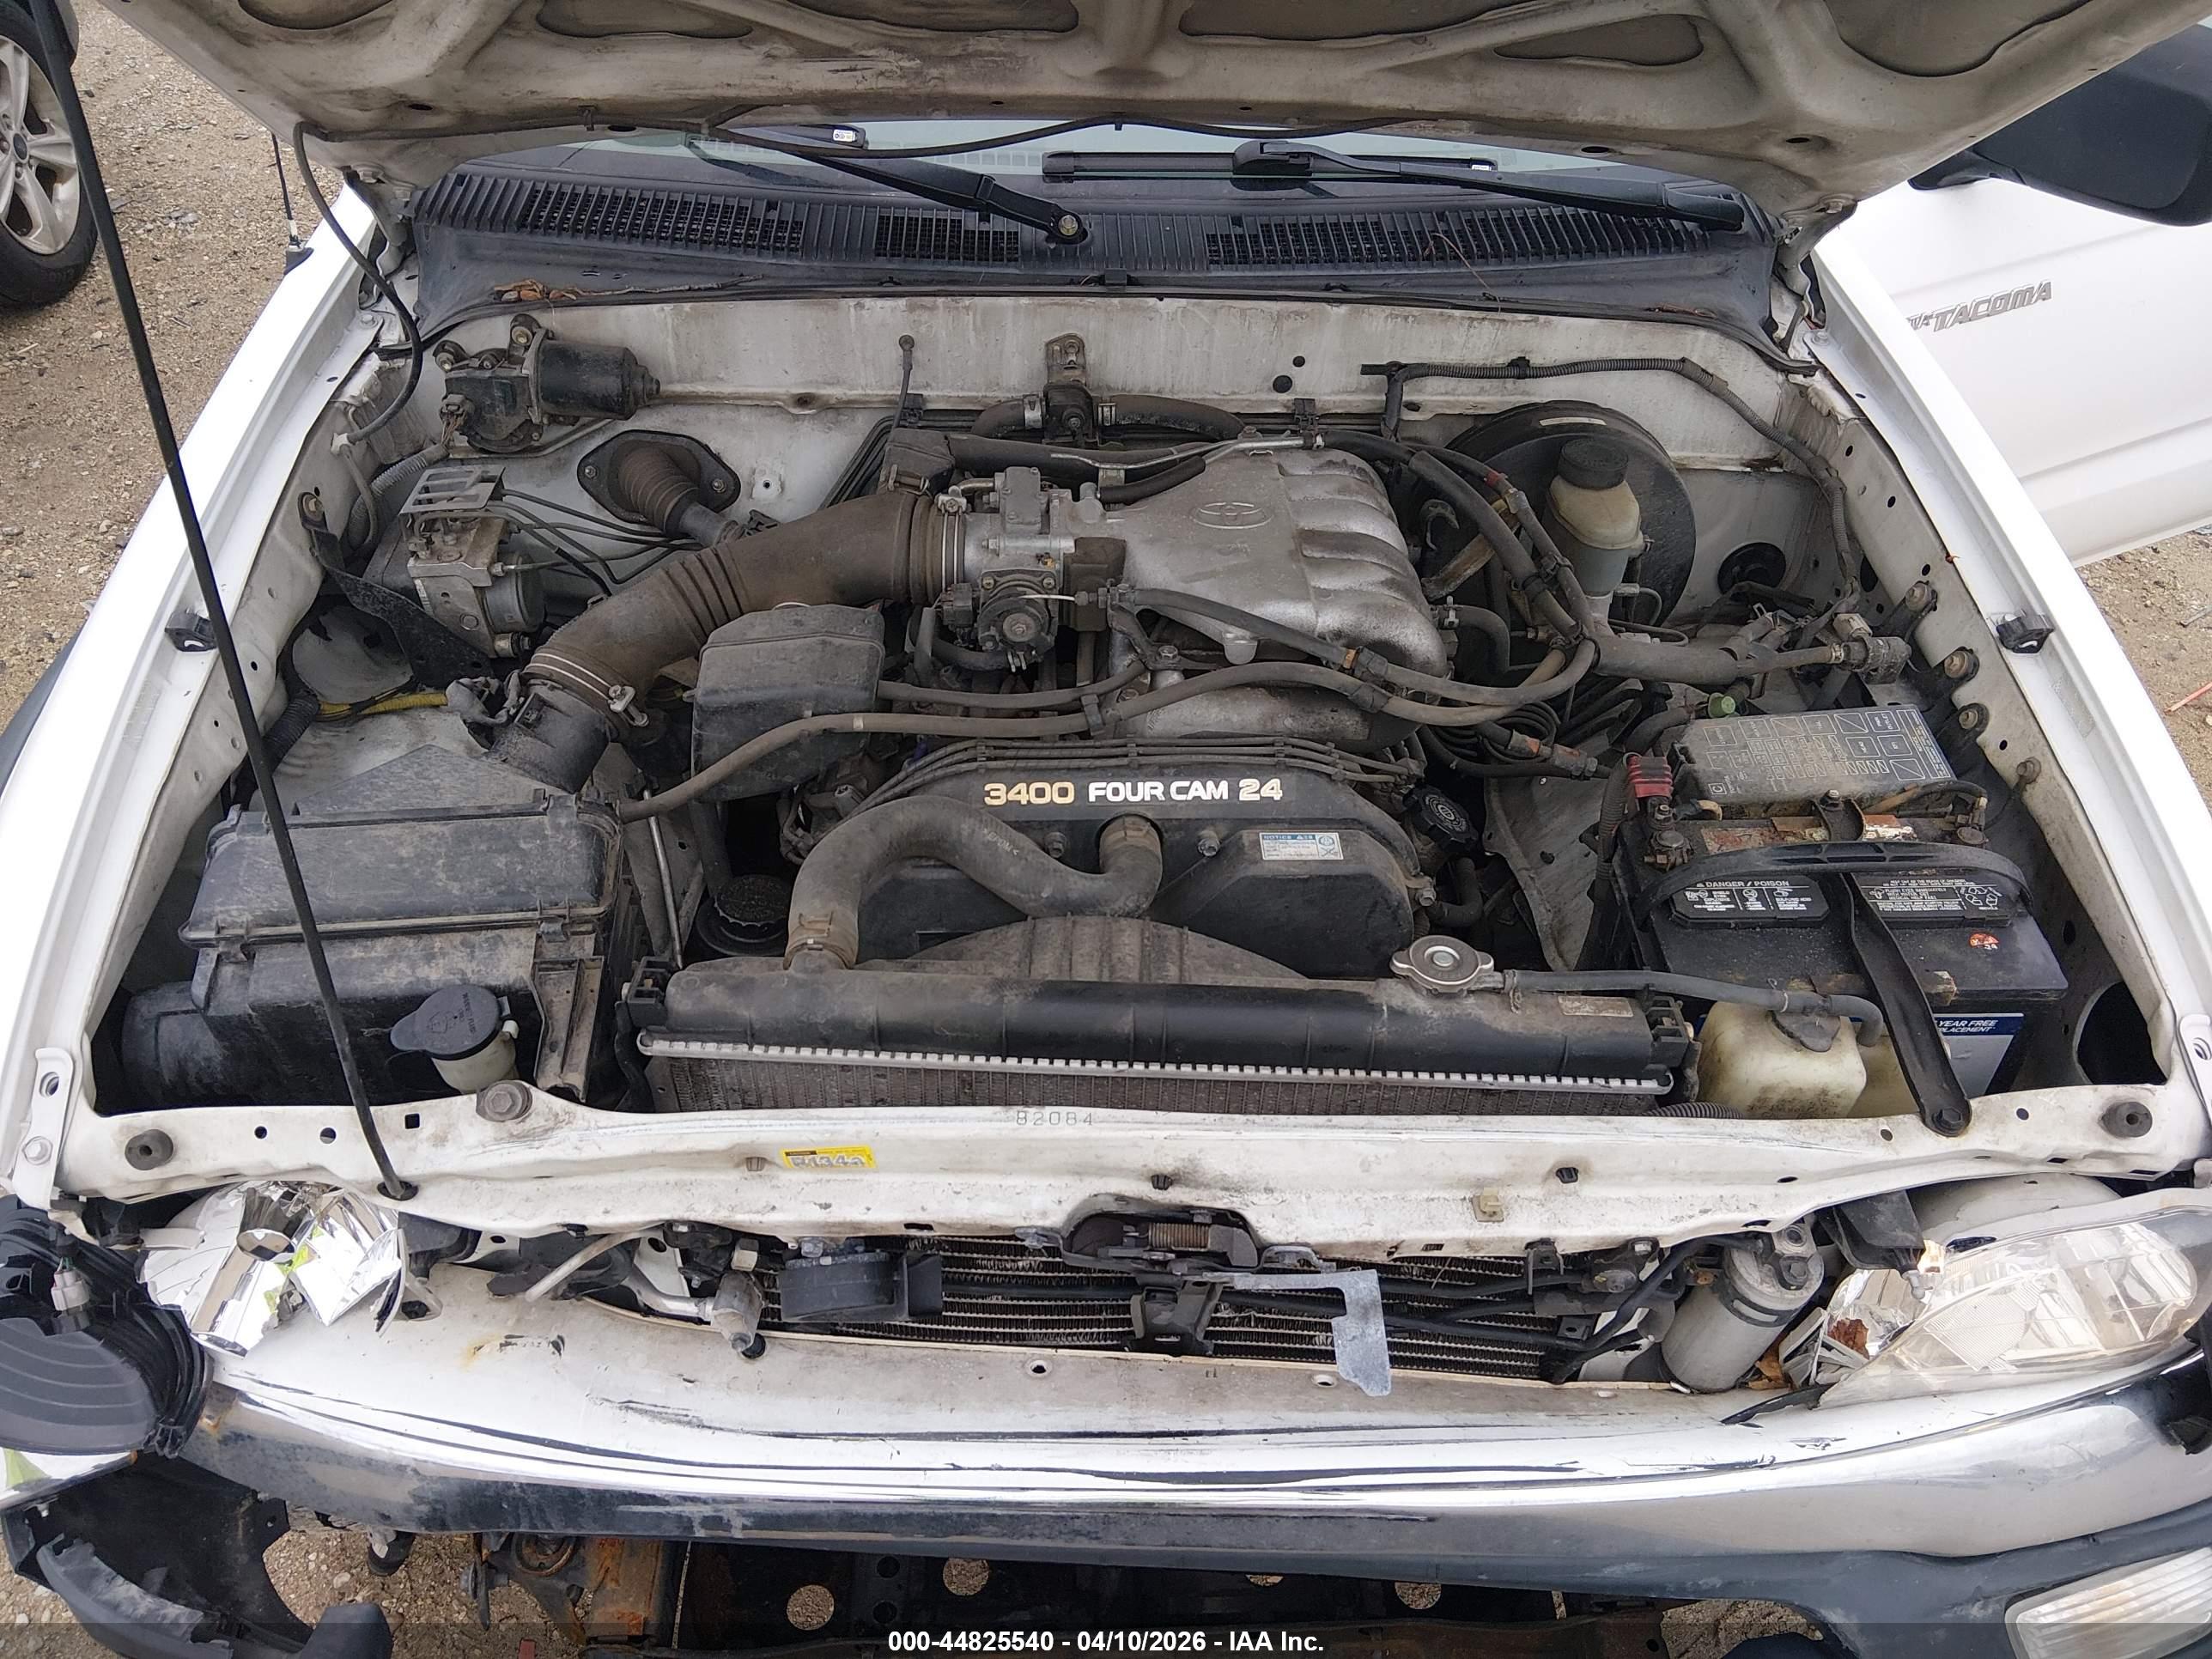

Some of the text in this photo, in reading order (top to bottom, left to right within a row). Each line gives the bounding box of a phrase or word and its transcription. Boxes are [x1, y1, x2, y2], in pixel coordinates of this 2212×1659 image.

[1933, 280, 2051, 332] TACOMA
[984, 778, 1283, 805] 3400 FOUR CAM 24
[1017, 1110, 1092, 1126] 82084
